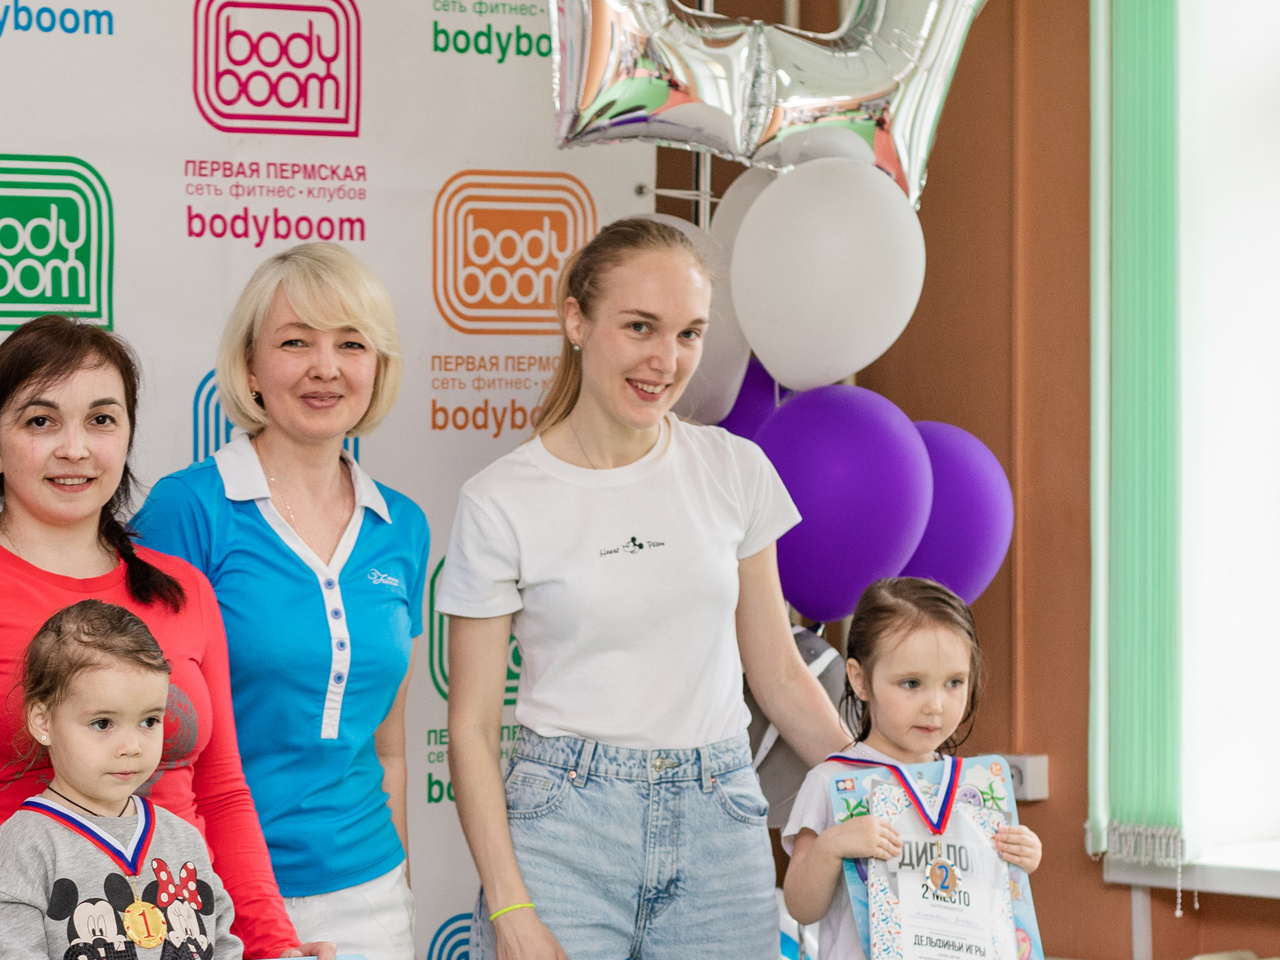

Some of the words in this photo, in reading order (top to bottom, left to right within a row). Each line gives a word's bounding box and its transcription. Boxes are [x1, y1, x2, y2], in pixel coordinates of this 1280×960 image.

[225, 14, 339, 70] body
[433, 20, 552, 63] bodybo
[215, 69, 340, 110] boom
[184, 160, 260, 179] ПЕРВАЯ
[266, 162, 367, 182] ПЕРМСКАЯ
[185, 183, 221, 197] сеть
[186, 205, 366, 247] bodyboom
[467, 214, 573, 267] body
[431, 355, 500, 372] ПЕРВАЯ
[431, 377, 466, 390] сеть
[431, 398, 543, 439] bodybo
[922, 884, 929, 899] 2
[937, 865, 950, 890] 2
[138, 909, 156, 939] 1
